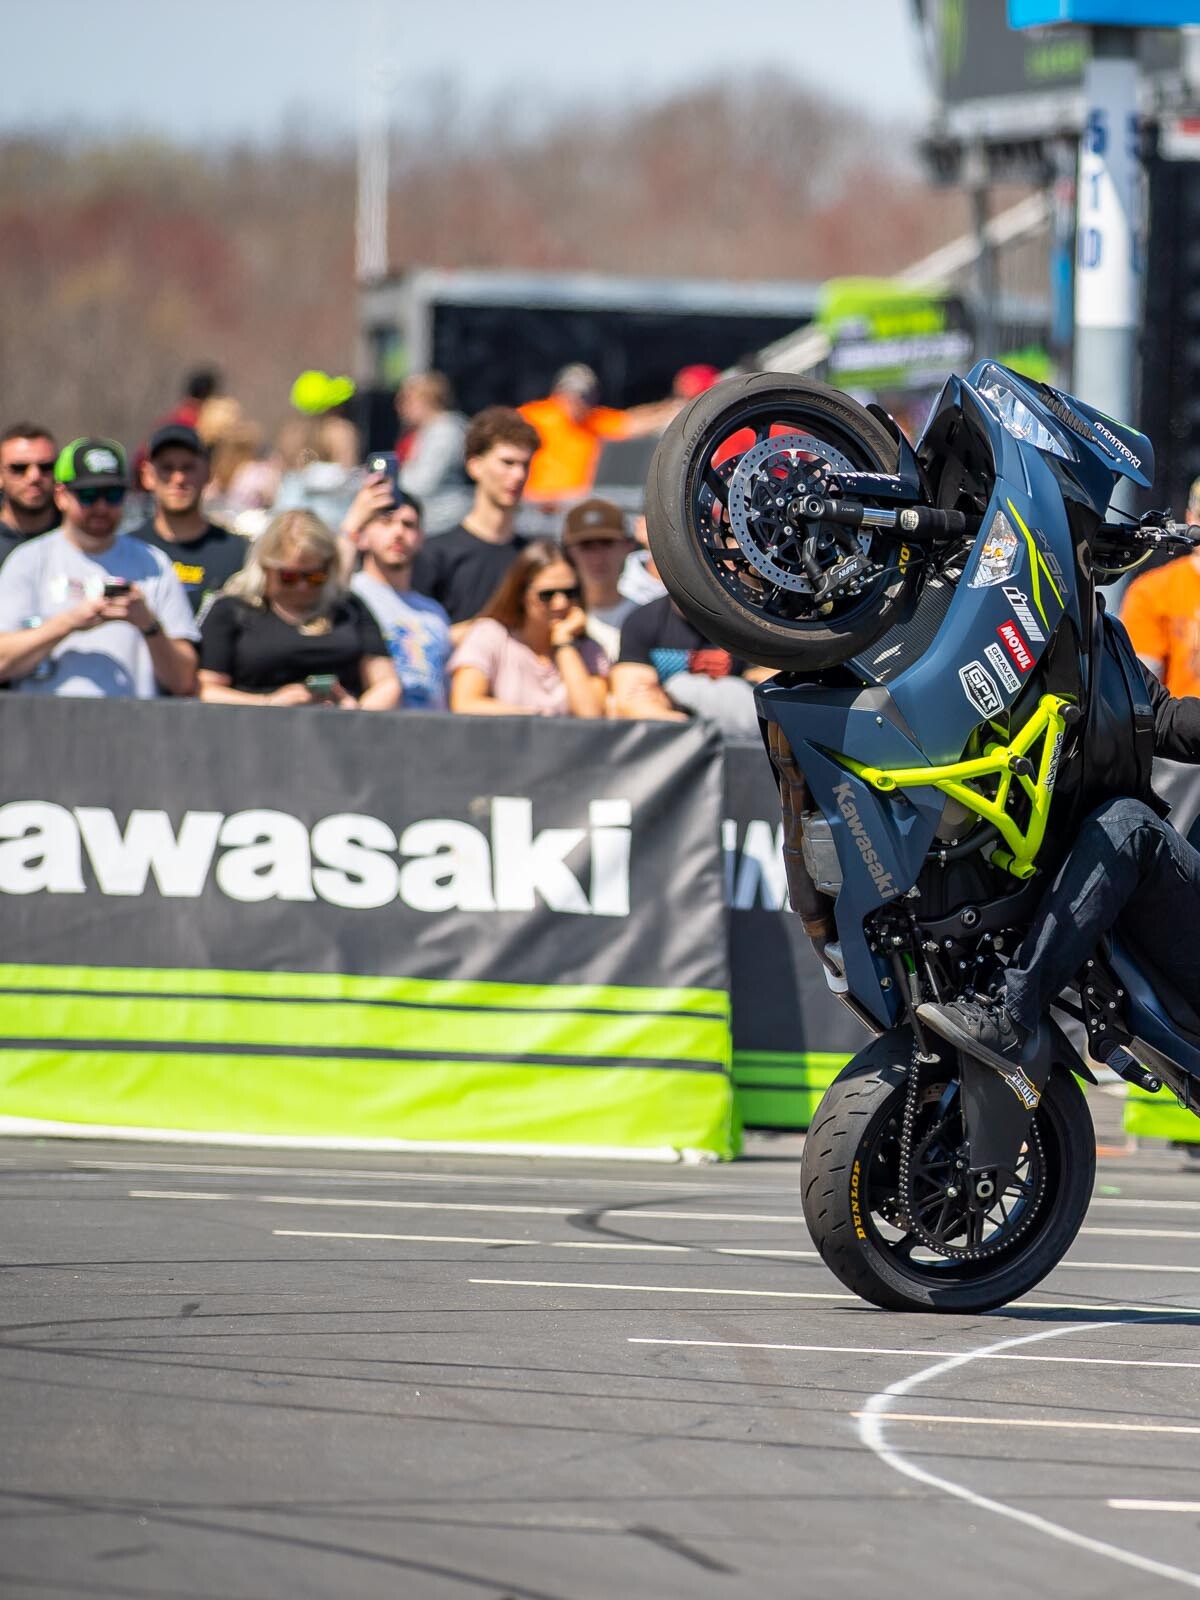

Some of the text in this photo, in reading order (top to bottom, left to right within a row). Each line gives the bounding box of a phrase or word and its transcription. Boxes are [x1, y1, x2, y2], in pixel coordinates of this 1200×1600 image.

[991, 647, 1018, 688] GRAVES
[1001, 626, 1032, 669] MOTUL
[968, 668, 998, 710] GPR
[831, 782, 899, 898] Kawasaki
[850, 1160, 867, 1240] DUNLOP
